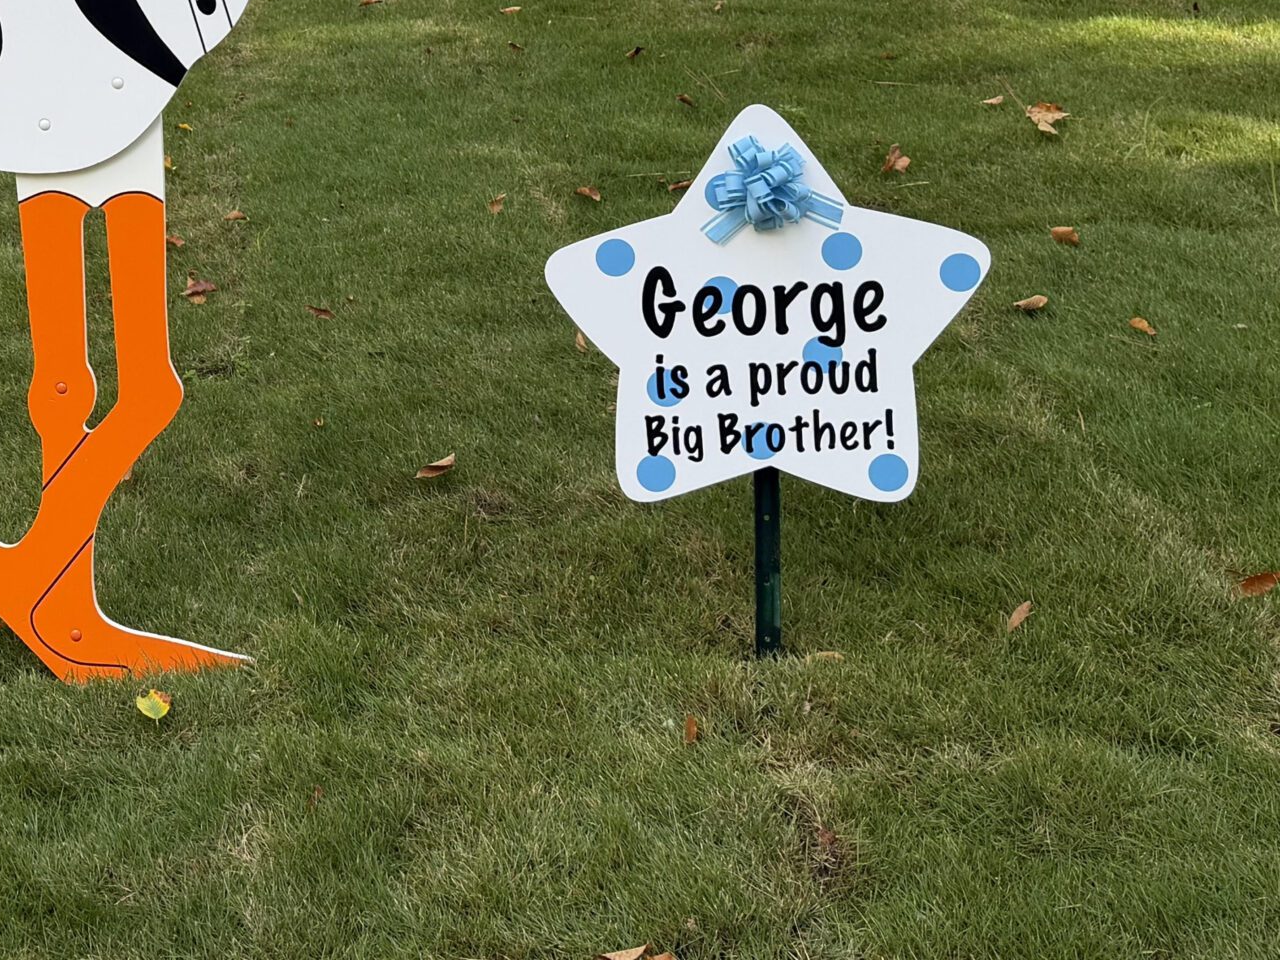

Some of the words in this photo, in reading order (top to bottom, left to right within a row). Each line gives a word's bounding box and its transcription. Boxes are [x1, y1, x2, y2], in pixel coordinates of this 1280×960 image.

[641, 265, 888, 348] George
[654, 353, 691, 400] is
[705, 364, 733, 399] a
[748, 347, 879, 408] proud
[643, 414, 705, 463] Big
[716, 408, 896, 455] Brother!
